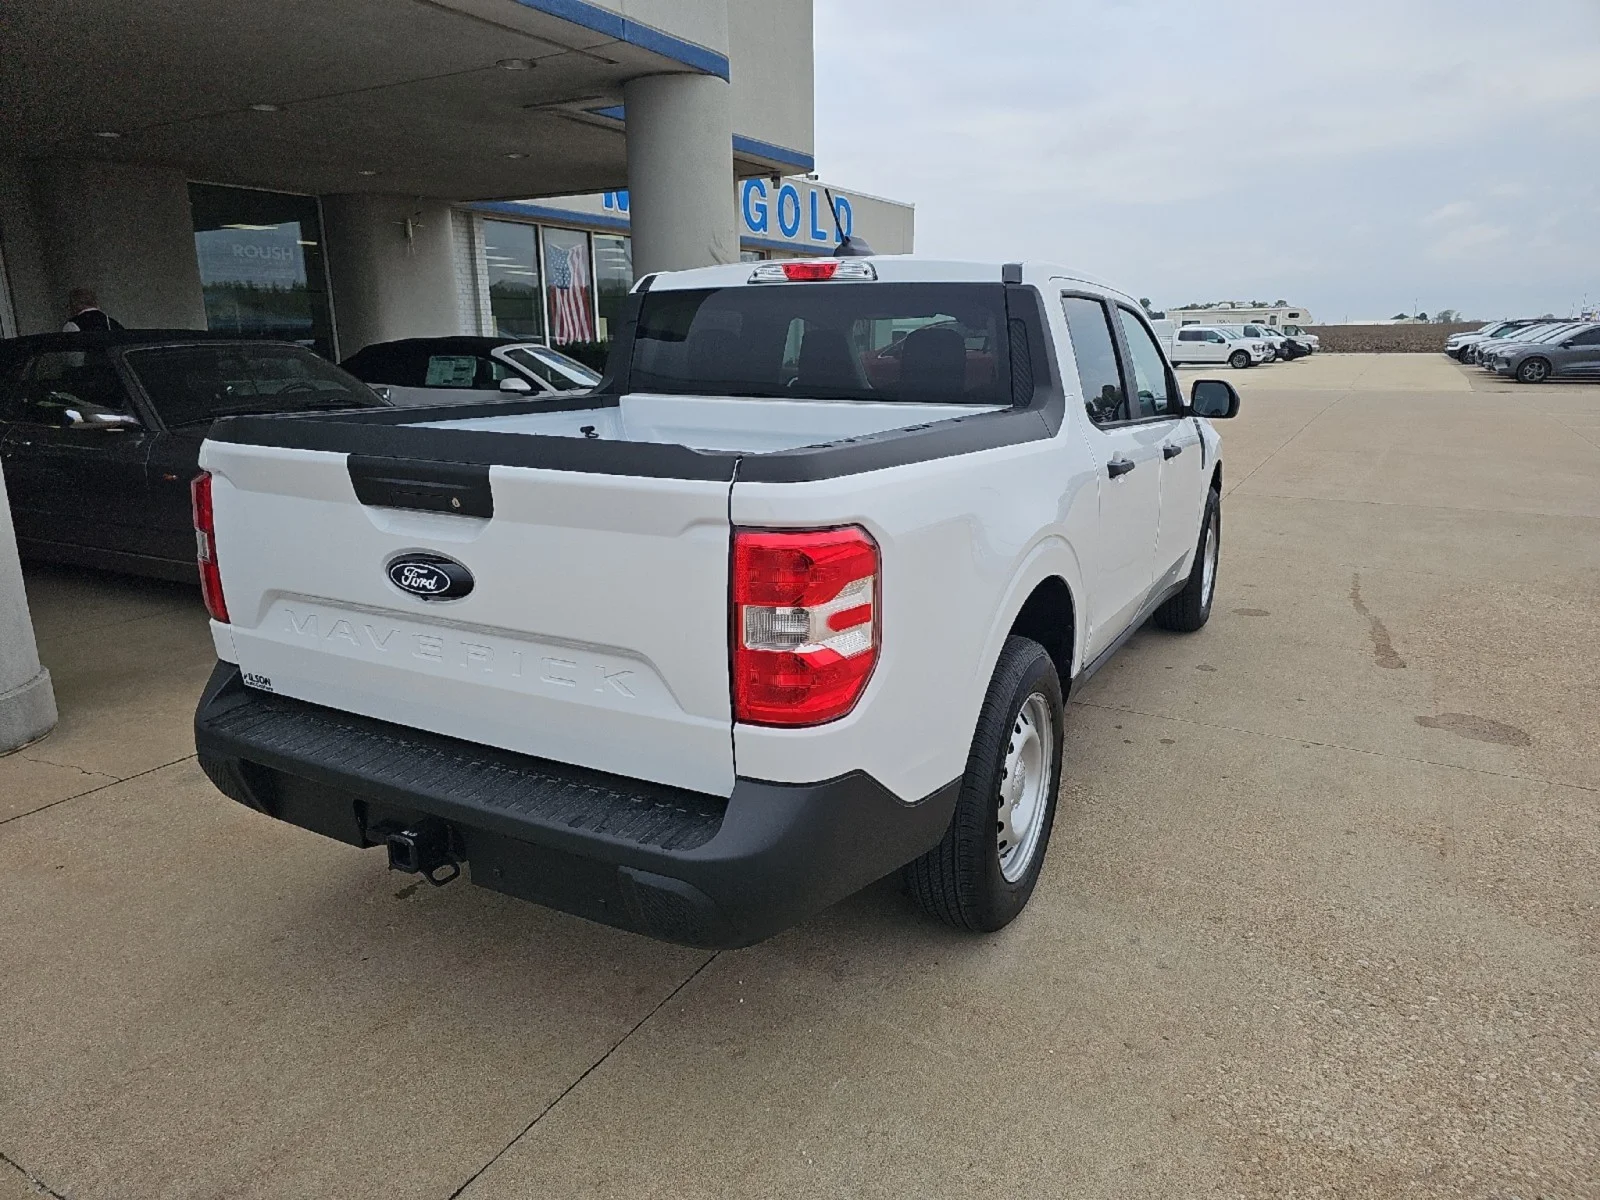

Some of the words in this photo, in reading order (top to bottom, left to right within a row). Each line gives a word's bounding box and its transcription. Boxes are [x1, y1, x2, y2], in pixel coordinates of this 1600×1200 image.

[232, 243, 294, 261] ROUSH
[401, 566, 438, 590] Ford
[284, 608, 637, 699] MAVERICK
